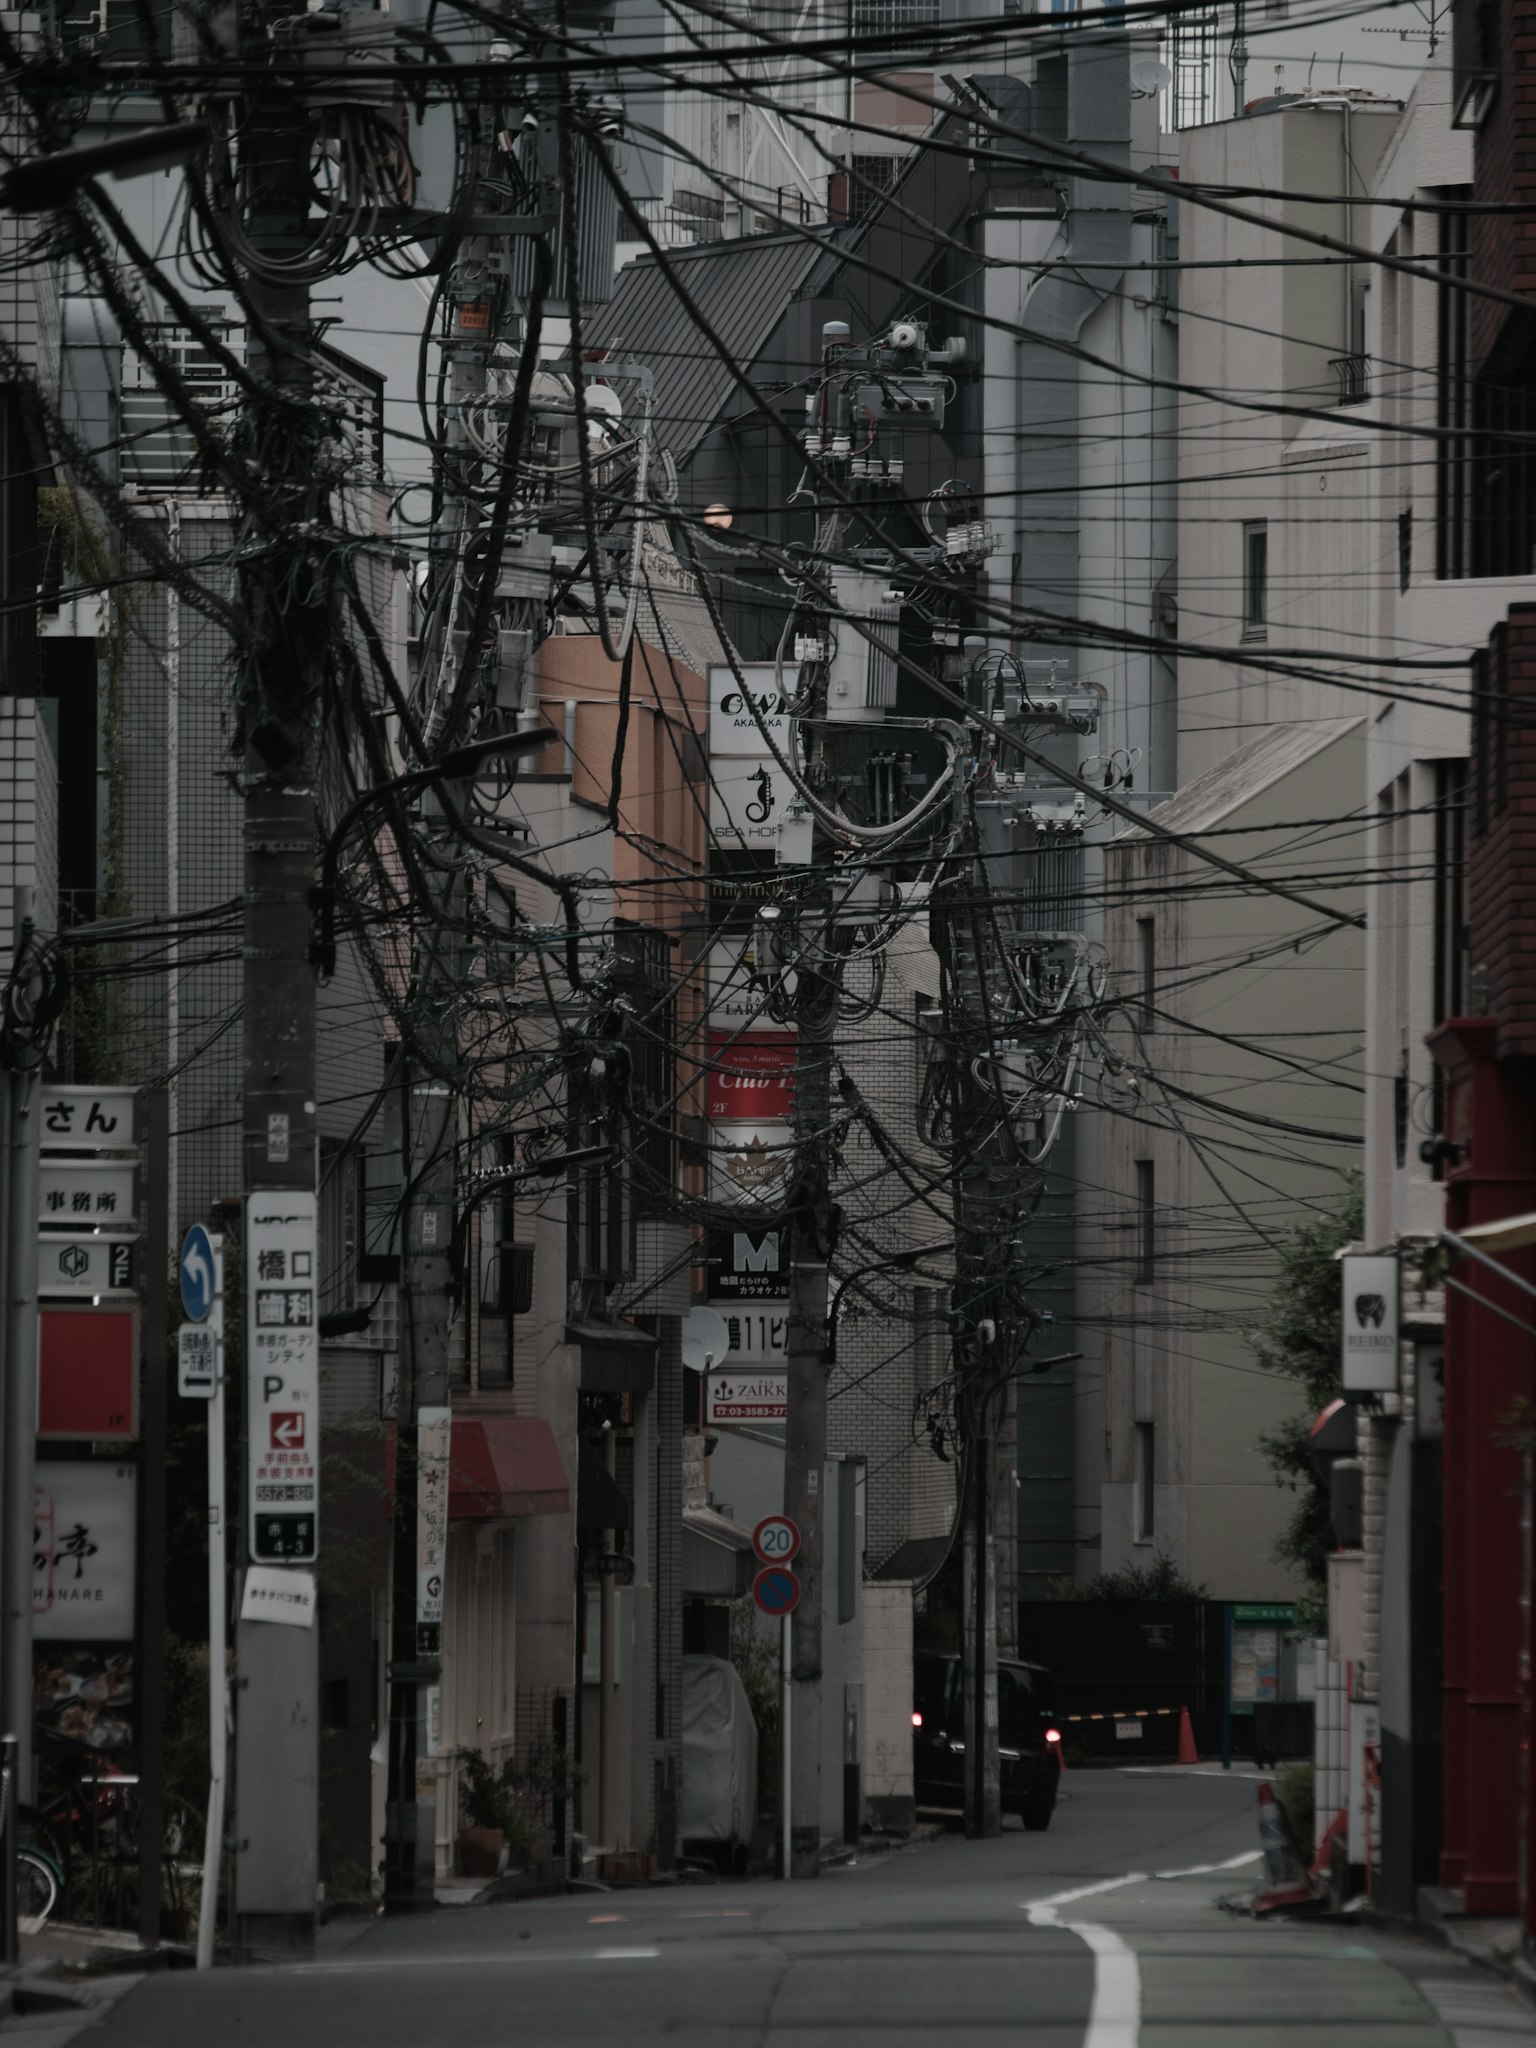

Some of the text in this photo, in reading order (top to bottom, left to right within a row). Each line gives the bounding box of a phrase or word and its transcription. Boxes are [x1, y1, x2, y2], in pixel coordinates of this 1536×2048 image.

[734, 719, 782, 727] AKAAKA
[715, 827, 744, 837] SEA
[712, 1102, 729, 1113] 2F
[45, 1102, 117, 1133] さん
[47, 1191, 117, 1212] 事務所
[257, 1250, 312, 1281] 橋口
[257, 1291, 311, 1325] 歯科
[1349, 1335, 1394, 1348] REIKO
[267, 1351, 305, 1364] シティ
[264, 1376, 283, 1403] P
[108, 1415, 124, 1427] 1F
[116, 1468, 133, 1478] B1
[272, 1540, 305, 1554] 4-3
[763, 1530, 790, 1551] 20
